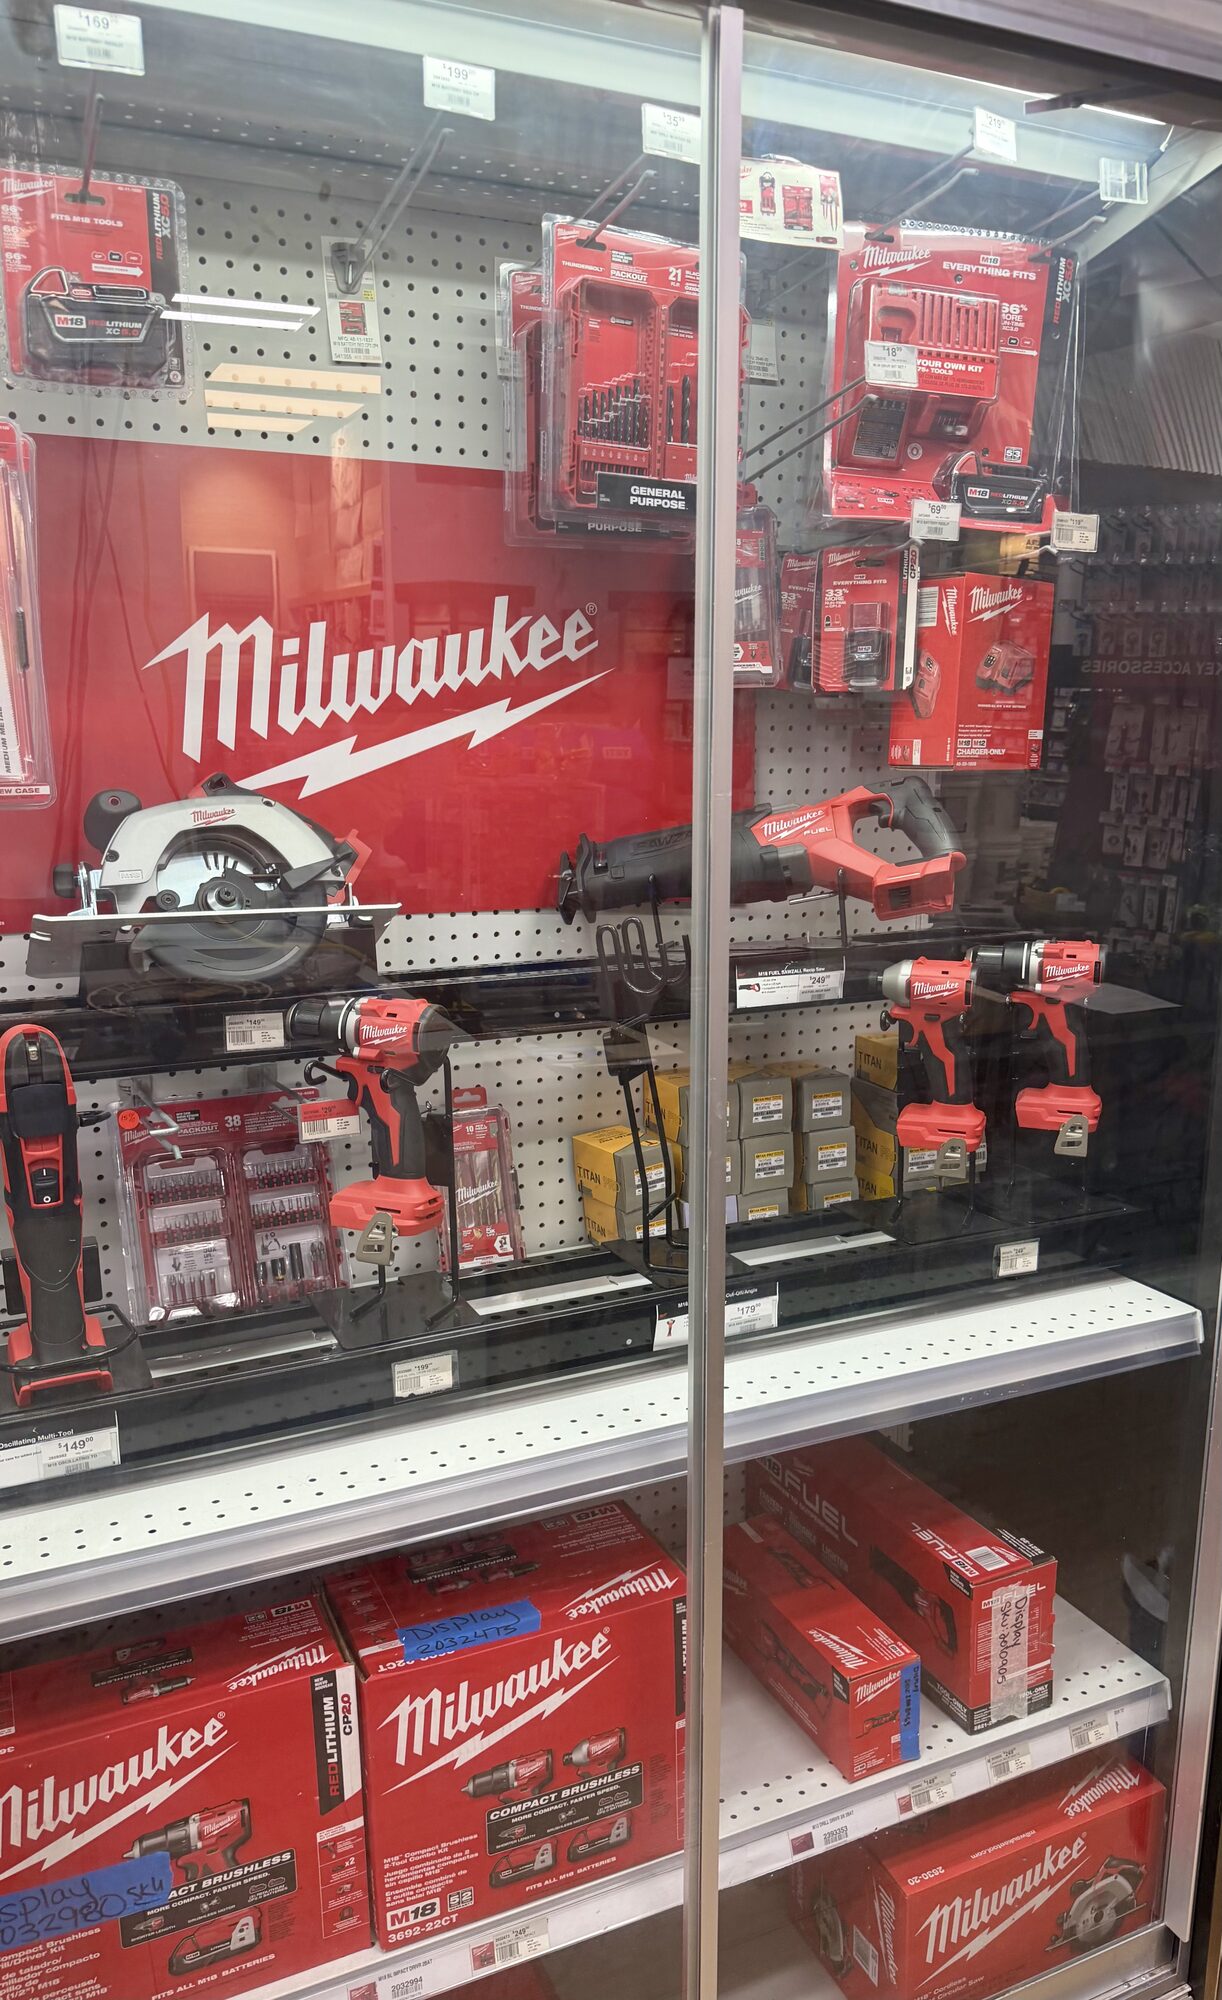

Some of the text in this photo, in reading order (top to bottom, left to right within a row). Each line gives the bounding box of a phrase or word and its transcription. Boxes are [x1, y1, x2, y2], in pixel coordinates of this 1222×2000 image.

[2, 177, 55, 194] Milwaukee
[51, 213, 71, 221] FITS
[94, 218, 124, 228] TOOLS
[152, 192, 164, 260] REDLITHIUM
[562, 261, 604, 272] THUNDERBOLT
[858, 245, 932, 269] Milwaukee
[981, 256, 999, 265] M18
[611, 269, 648, 282] PACKOUT
[669, 267, 681, 282] 21
[943, 262, 1036, 280] EVERYTHING FITS
[1052, 257, 1067, 325] REDLITHIUM
[56, 316, 84, 327] M18
[917, 359, 942, 368] YOUR
[944, 361, 966, 371] OWN
[968, 365, 984, 373] KIT
[931, 368, 954, 376] TOOLS
[631, 485, 686, 500] GENERAL
[968, 487, 988, 498] M18
[630, 495, 686, 511] PURPOSE
[828, 550, 862, 564] Milwaukee
[968, 584, 1023, 613] Milwaukee
[946, 585, 959, 636] Milwaukee
[142, 595, 599, 764] Milwaukee
[3, 737, 12, 774] MEDIUM
[15, 787, 41, 795] CASE
[190, 807, 236, 823] Milwaukee
[761, 807, 826, 838] Milwaukee
[803, 825, 833, 837] FUEL
[1044, 961, 1091, 978] Milwaukee
[911, 981, 960, 996] Milwaukee
[360, 1024, 408, 1042] Milwaukee
[859, 1050, 882, 1070] TITAN
[224, 1114, 241, 1129] 38
[466, 1125, 474, 1133] 10
[577, 1165, 601, 1185] TITAN
[455, 1180, 499, 1202] Milwaukee
[587, 1217, 606, 1237] TITAN
[38, 1428, 75, 1442] Multi-Tool
[785, 1469, 858, 1548] FUEL
[912, 1522, 959, 1567] FUEL
[954, 1560, 978, 1577] M18
[566, 1567, 680, 1619] Milwaukee
[273, 1600, 310, 1616] M18
[808, 1629, 868, 1670] Milwaukee
[227, 1644, 335, 1690] Milwaukee
[855, 1670, 902, 1702] Milwaukee
[377, 1633, 612, 1766] Milwaukee
[341, 1692, 353, 1736] CP2.0
[323, 1695, 339, 1797] REDLITHIUM
[591, 1736, 619, 1755] Milwaukee
[490, 1765, 641, 1821] COMPACT BRUSHLESS
[1065, 1761, 1140, 1819] Milwaukee
[511, 1784, 621, 1823] MORE COMPACT. FASTER SPEED.
[202, 1812, 239, 1837] Milwaukee
[383, 1833, 478, 1864] M18 Compact Brushless
[383, 1860, 408, 1869] 2-Tool
[409, 1851, 437, 1862] Combo
[384, 1868, 409, 1878] Juego
[409, 1854, 452, 1872] combinado
[201, 1852, 292, 1889] BRUSHLESS
[384, 1865, 436, 1883] herramientas
[425, 1869, 441, 1877] M18
[525, 1856, 617, 1892] FITS ALL M18 BATTERIES
[907, 1866, 945, 1886] 2630-20
[147, 1904, 171, 1916] MORE
[172, 1892, 212, 1908] COMPACT.
[213, 1881, 242, 1895] FASTER
[244, 1871, 270, 1884] SPEED.
[385, 1884, 423, 1897] Ensemble
[393, 1879, 454, 1900] outils compacts
[386, 1900, 405, 1908] sans
[406, 1893, 425, 1902] balai
[915, 1836, 1088, 1964] Milwaukee
[389, 1901, 437, 1928] M18
[46, 1927, 101, 1949] Brushless
[387, 1913, 459, 1943] 3692-22CT
[878, 1883, 899, 1985] Milwaukee
[50, 1945, 66, 1955] Kit
[2, 1956, 62, 1981] de taladro/
[45, 1952, 101, 1974] compacto
[25, 1979, 39, 1987] de
[38, 1978, 60, 1989] M18
[152, 1953, 276, 2000] FITS ALL M18 BATTERIES
[391, 1975, 423, 1993] 2032994
[933, 1976, 967, 1995] Cordless
[968, 1975, 985, 1987] Saw
[75, 1984, 101, 1996] sans
